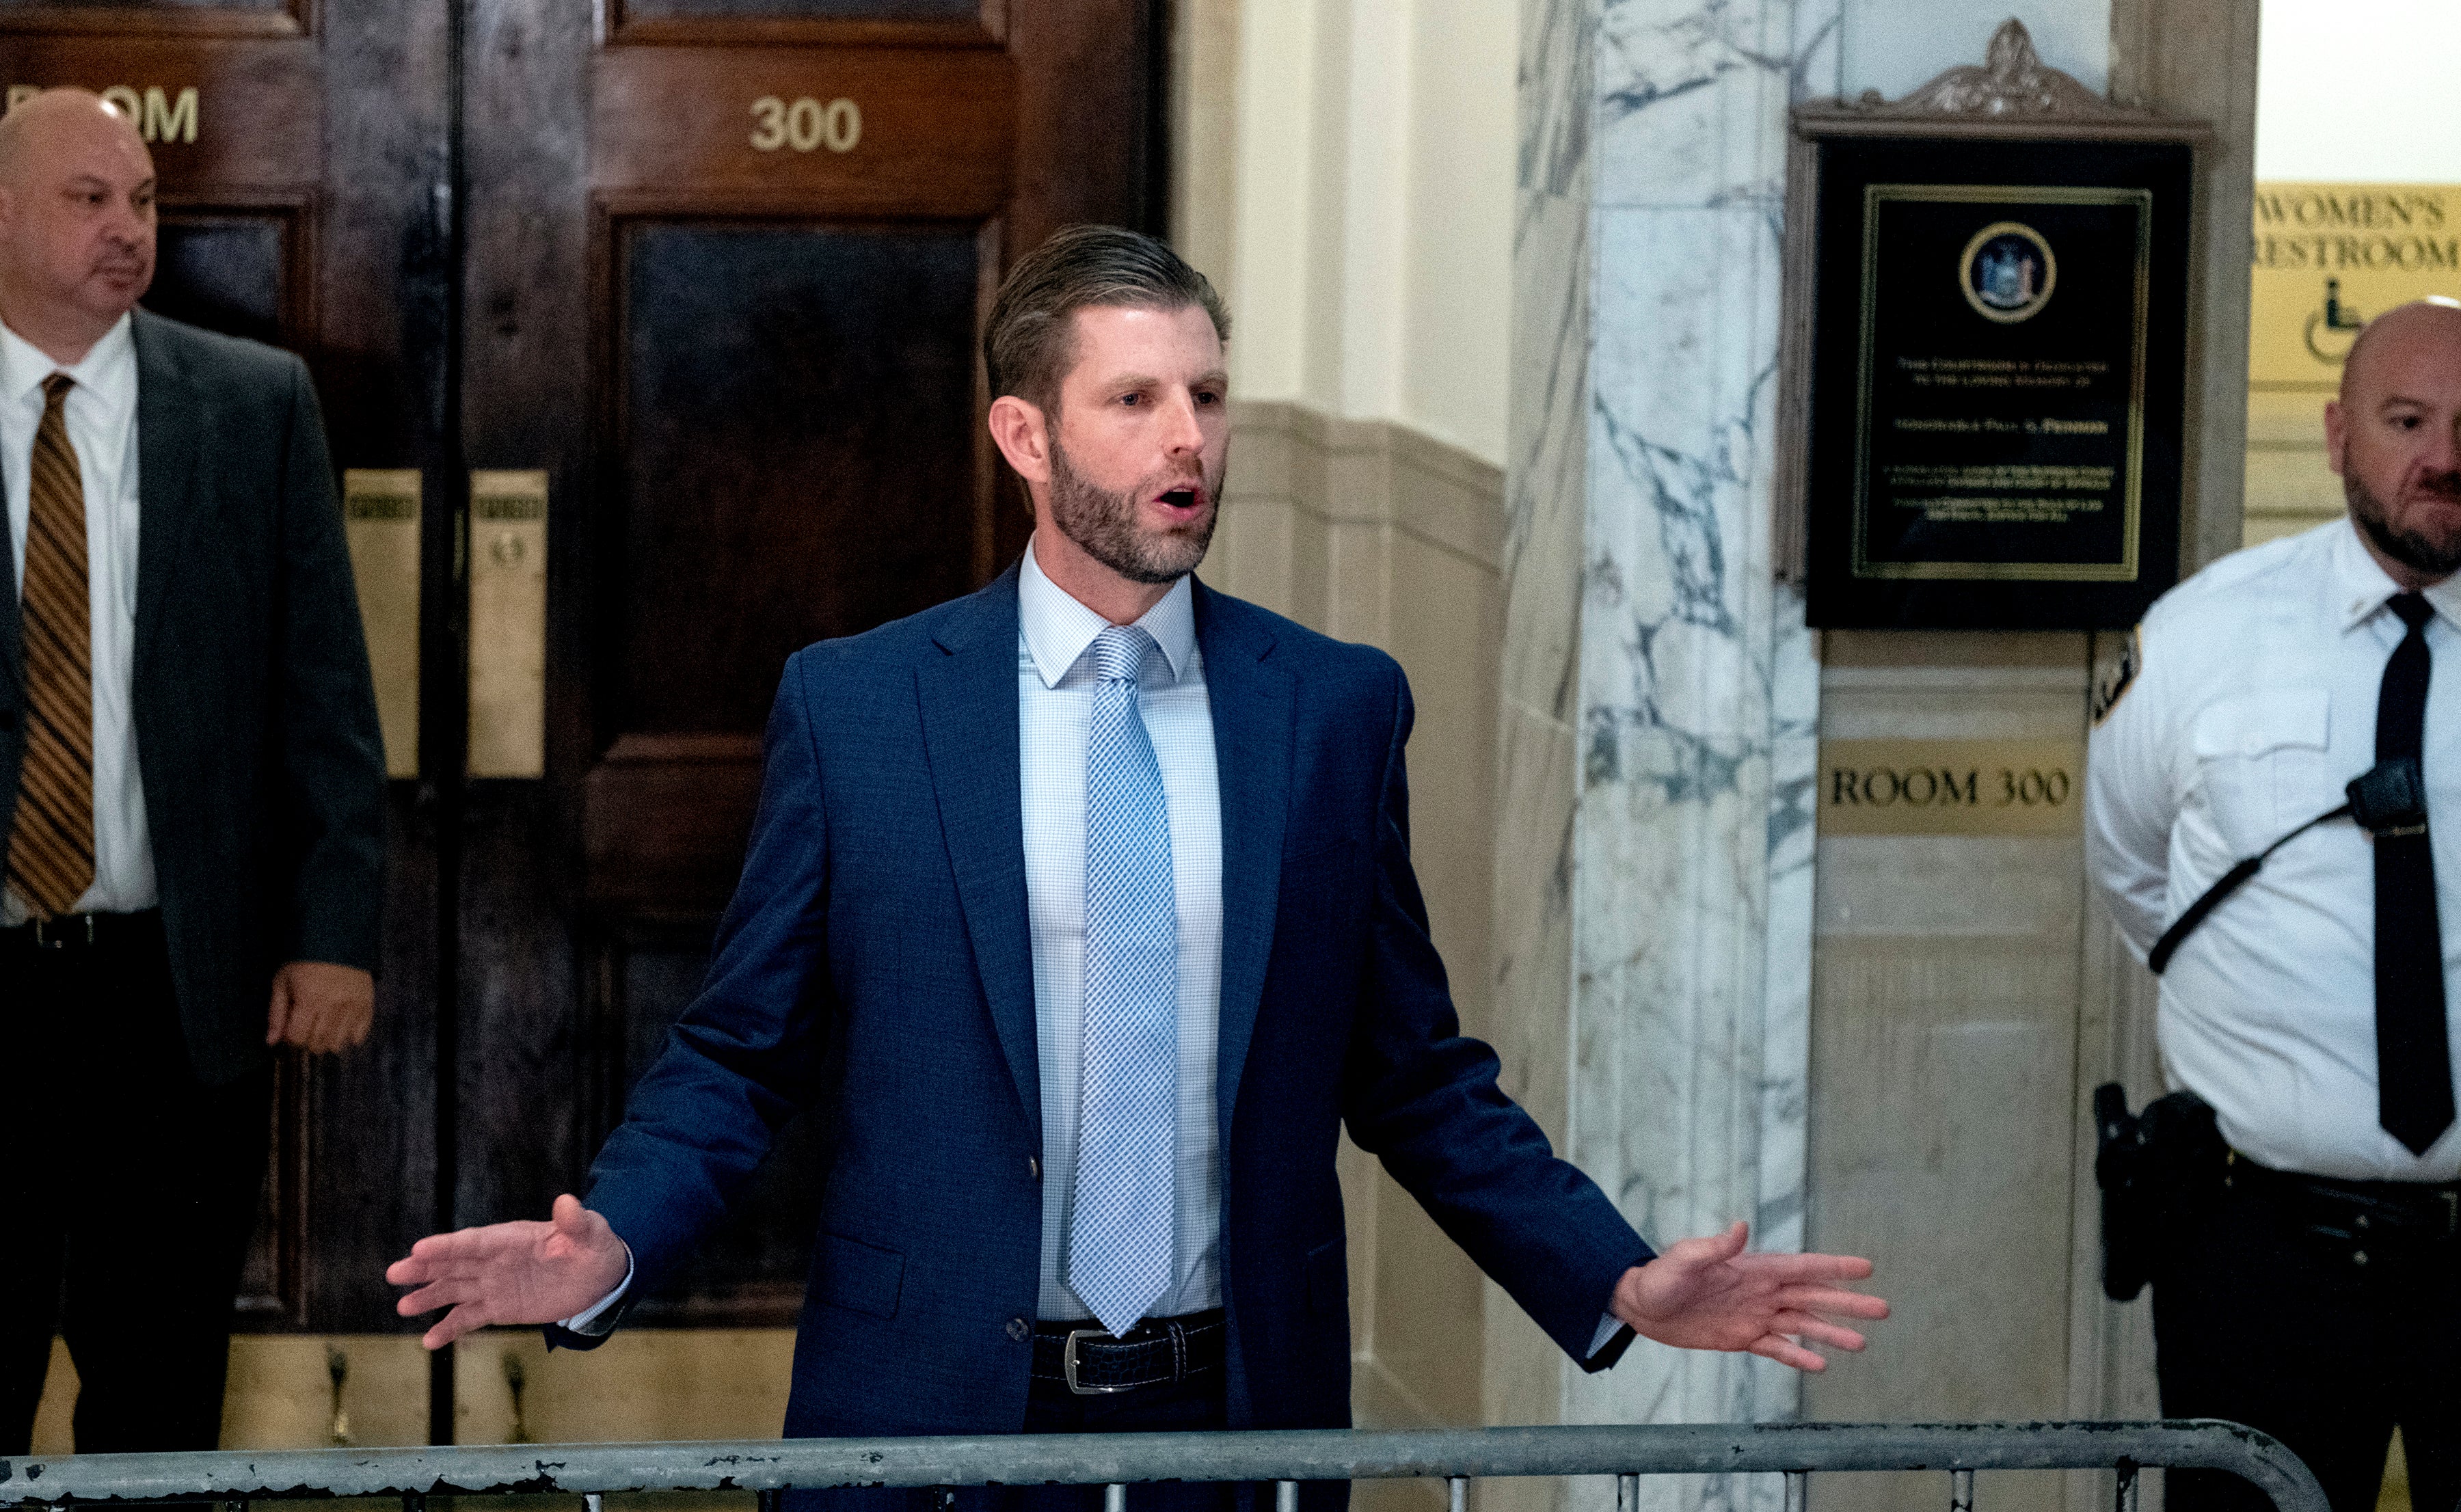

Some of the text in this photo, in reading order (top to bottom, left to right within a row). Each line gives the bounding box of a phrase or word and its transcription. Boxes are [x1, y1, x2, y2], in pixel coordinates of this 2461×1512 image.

[751, 95, 863, 153] 300
[2255, 193, 2445, 229] WOMEN'S
[1832, 767, 2071, 807] ROOM 300
